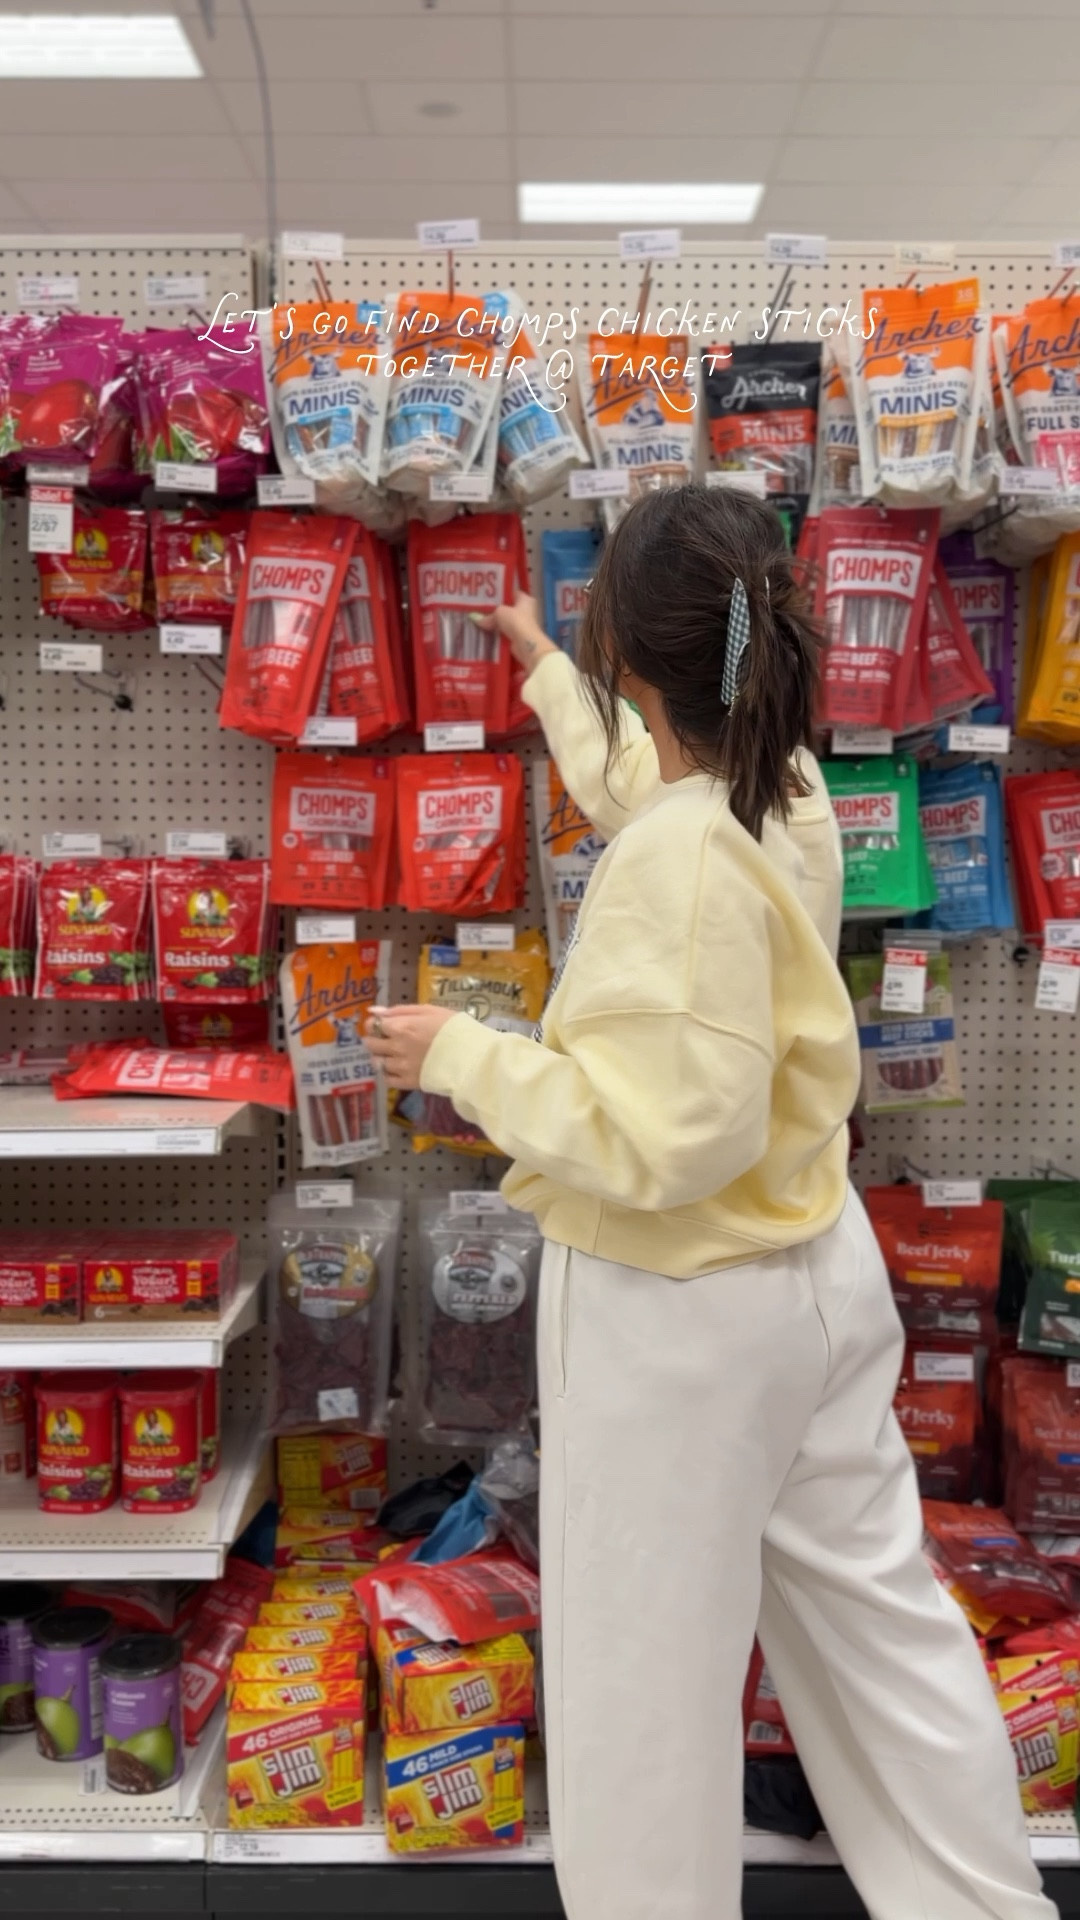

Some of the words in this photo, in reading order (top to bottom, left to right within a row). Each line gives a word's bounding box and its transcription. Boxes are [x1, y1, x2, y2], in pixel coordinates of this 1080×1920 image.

[857, 309, 985, 366] Archer
[1008, 323, 1080, 365] Arch
[288, 388, 361, 416] MINIS
[396, 384, 466, 408] MINIS
[721, 375, 807, 411] Archer
[880, 390, 958, 415] MINIS
[741, 418, 806, 443] MINIS
[1026, 417, 1066, 432] FULL
[617, 444, 684, 465] MINIS
[31, 520, 58, 532] 2/$7
[252, 565, 326, 594] CHOMPS
[832, 556, 913, 587] CHOMPS
[422, 570, 497, 603] CHOMPS
[954, 583, 1000, 609] OMPS
[299, 793, 367, 819] CHOMPS
[424, 790, 493, 818] CHOMPS
[1050, 811, 1080, 835] CHO
[165, 951, 230, 968] Raisins
[290, 966, 383, 1018] Archer
[318, 1069, 351, 1085] FULL
[352, 1066, 377, 1079] SIZ
[896, 1242, 930, 1255] Beef
[931, 1244, 973, 1263] Jerky
[0, 1276, 36, 1289] ogurt
[912, 1408, 957, 1429] Jerky
[123, 1464, 173, 1478] Raisins
[449, 1675, 489, 1703] slim
[456, 1690, 493, 1720] Jim
[241, 1731, 268, 1753] 46
[269, 1715, 322, 1740] ORIGINAL
[1015, 1731, 1054, 1759] lim
[262, 1744, 316, 1774] slim
[402, 1758, 428, 1777] 46
[428, 1745, 457, 1763] MILD
[274, 1763, 322, 1798] Jim
[422, 1766, 475, 1798] slim
[436, 1784, 483, 1819] Jim
